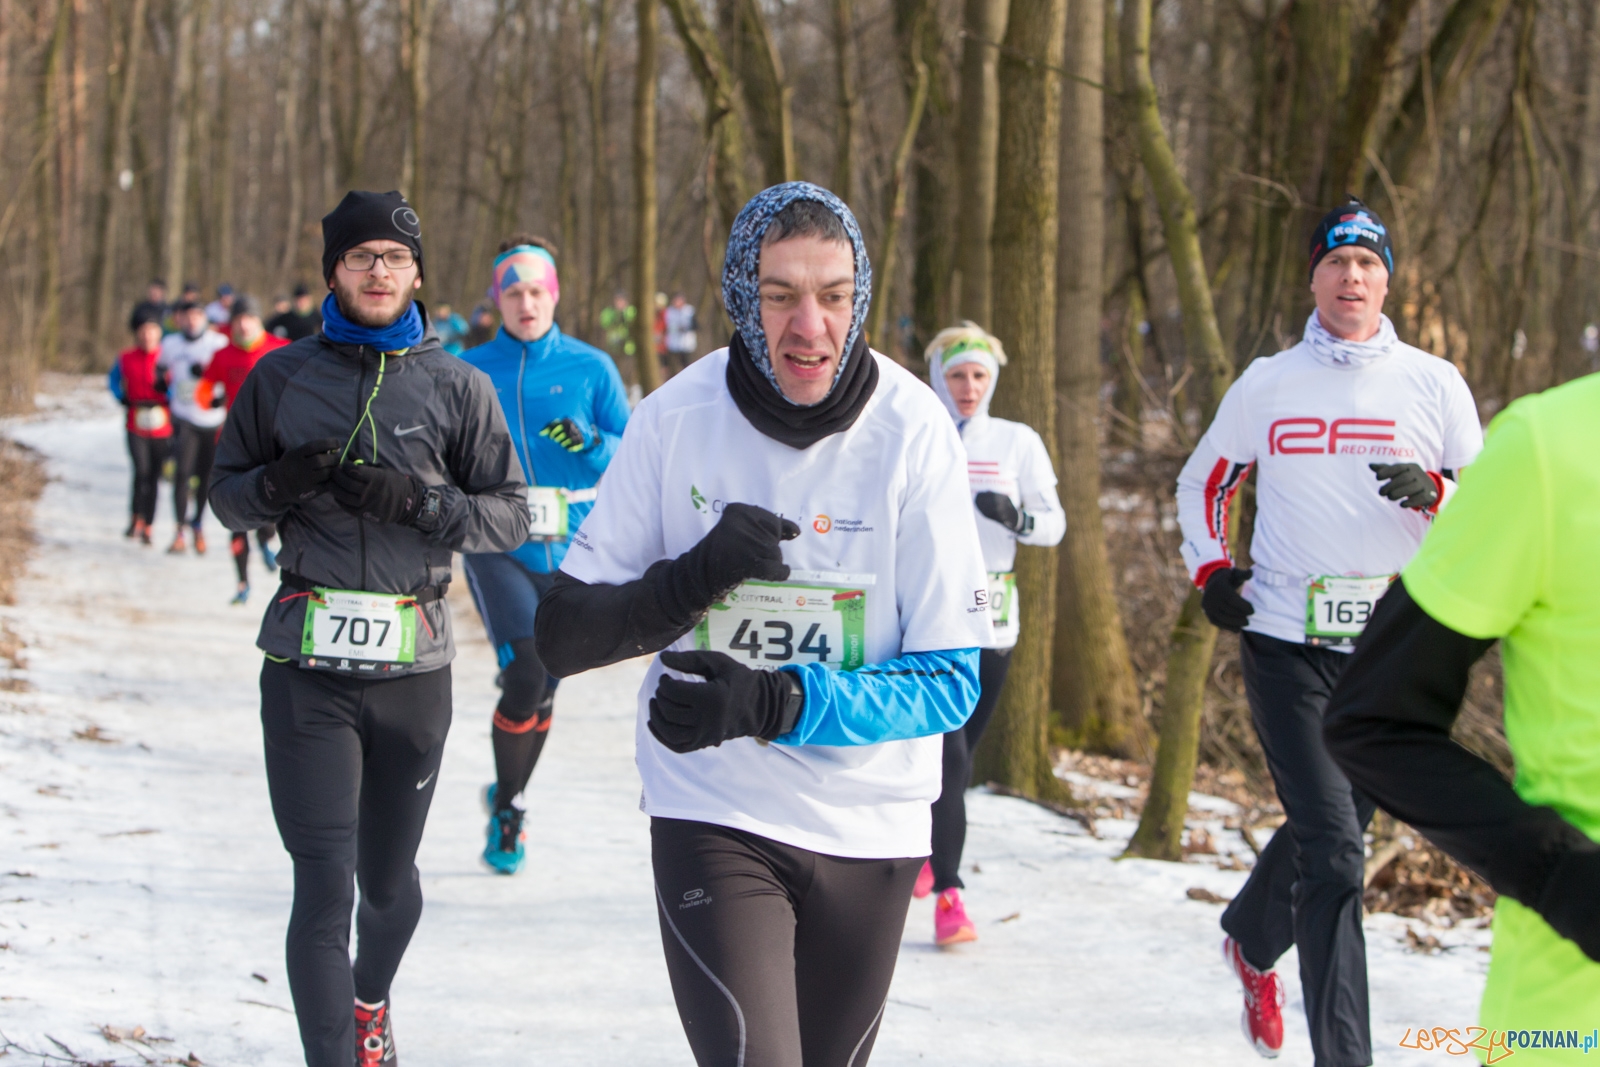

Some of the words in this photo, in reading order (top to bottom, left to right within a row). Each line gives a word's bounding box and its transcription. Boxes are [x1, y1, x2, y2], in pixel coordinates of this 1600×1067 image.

[1341, 444, 1366, 456] RED
[1369, 445, 1415, 458] FITNESS
[329, 615, 391, 648] 707
[729, 618, 832, 663] 434
